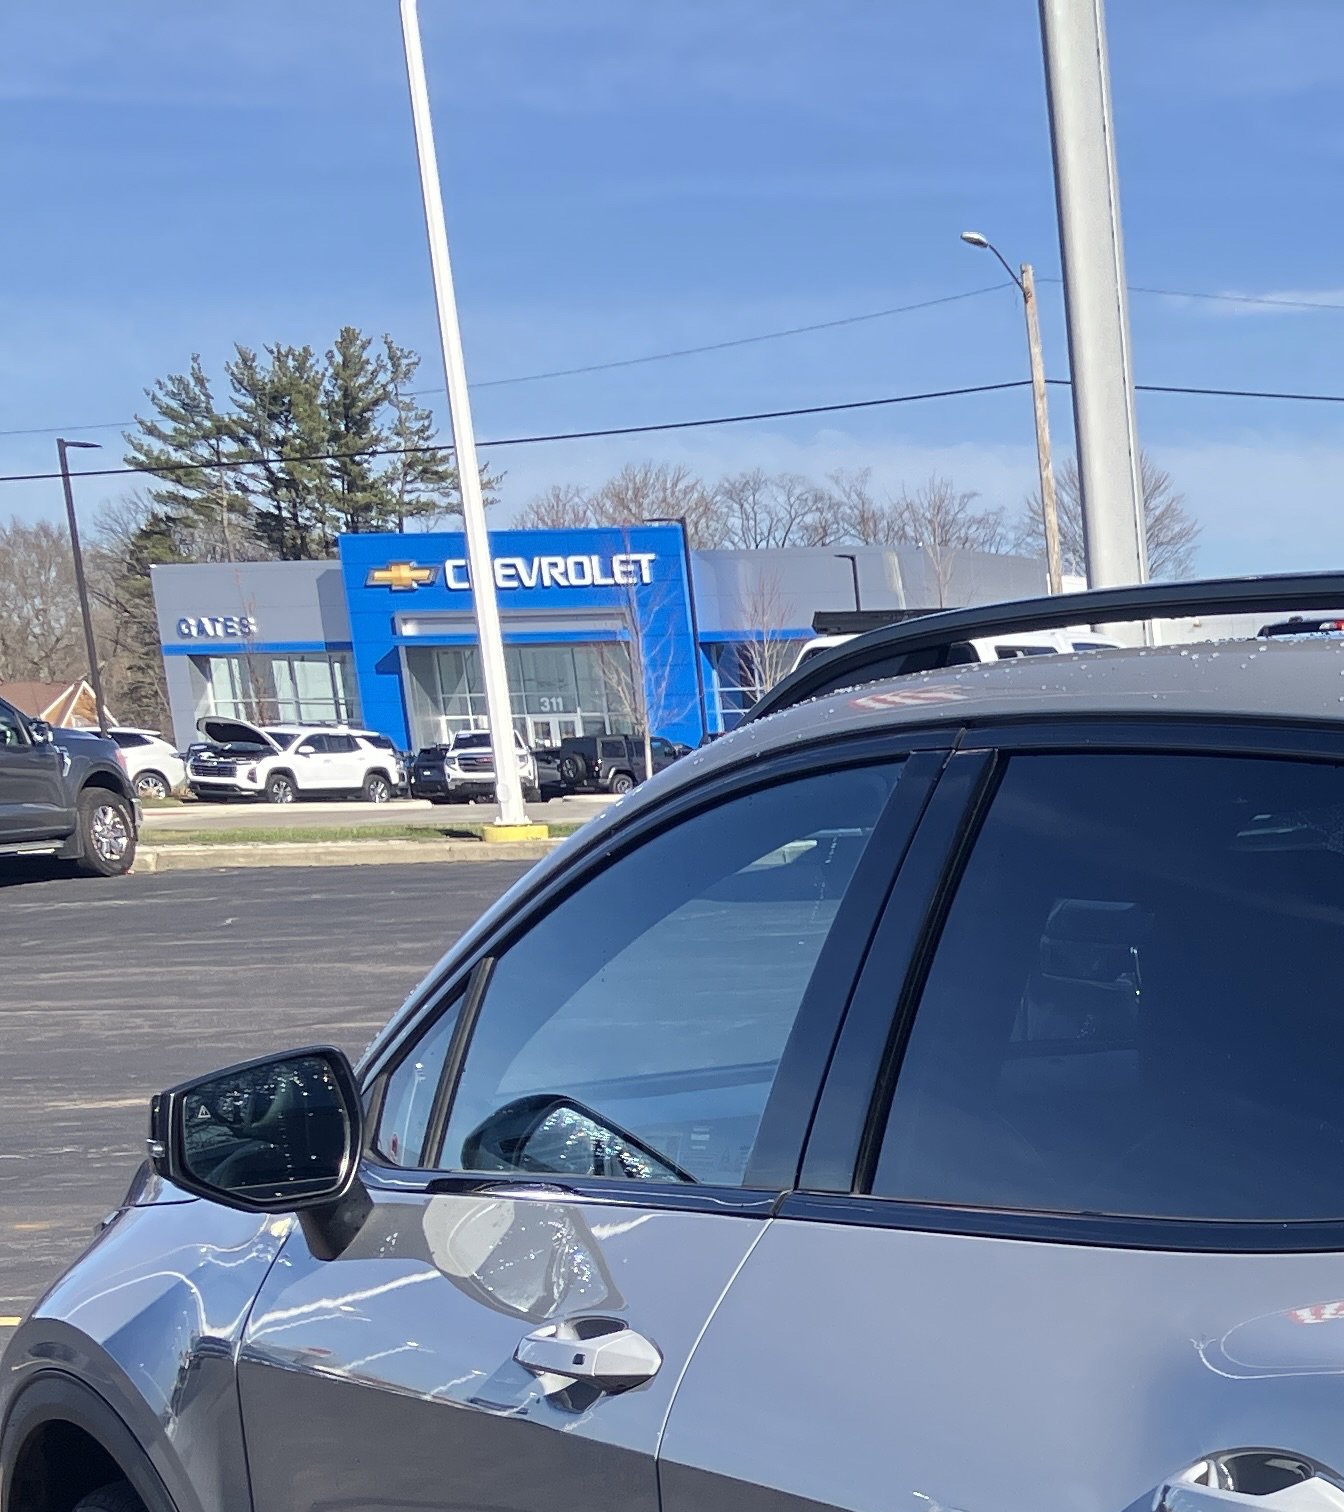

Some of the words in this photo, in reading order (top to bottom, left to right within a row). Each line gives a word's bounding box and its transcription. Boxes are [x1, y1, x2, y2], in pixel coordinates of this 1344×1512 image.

[445, 553, 656, 590] CEVROLET
[177, 616, 257, 638] GATES
[540, 697, 563, 712] 311
